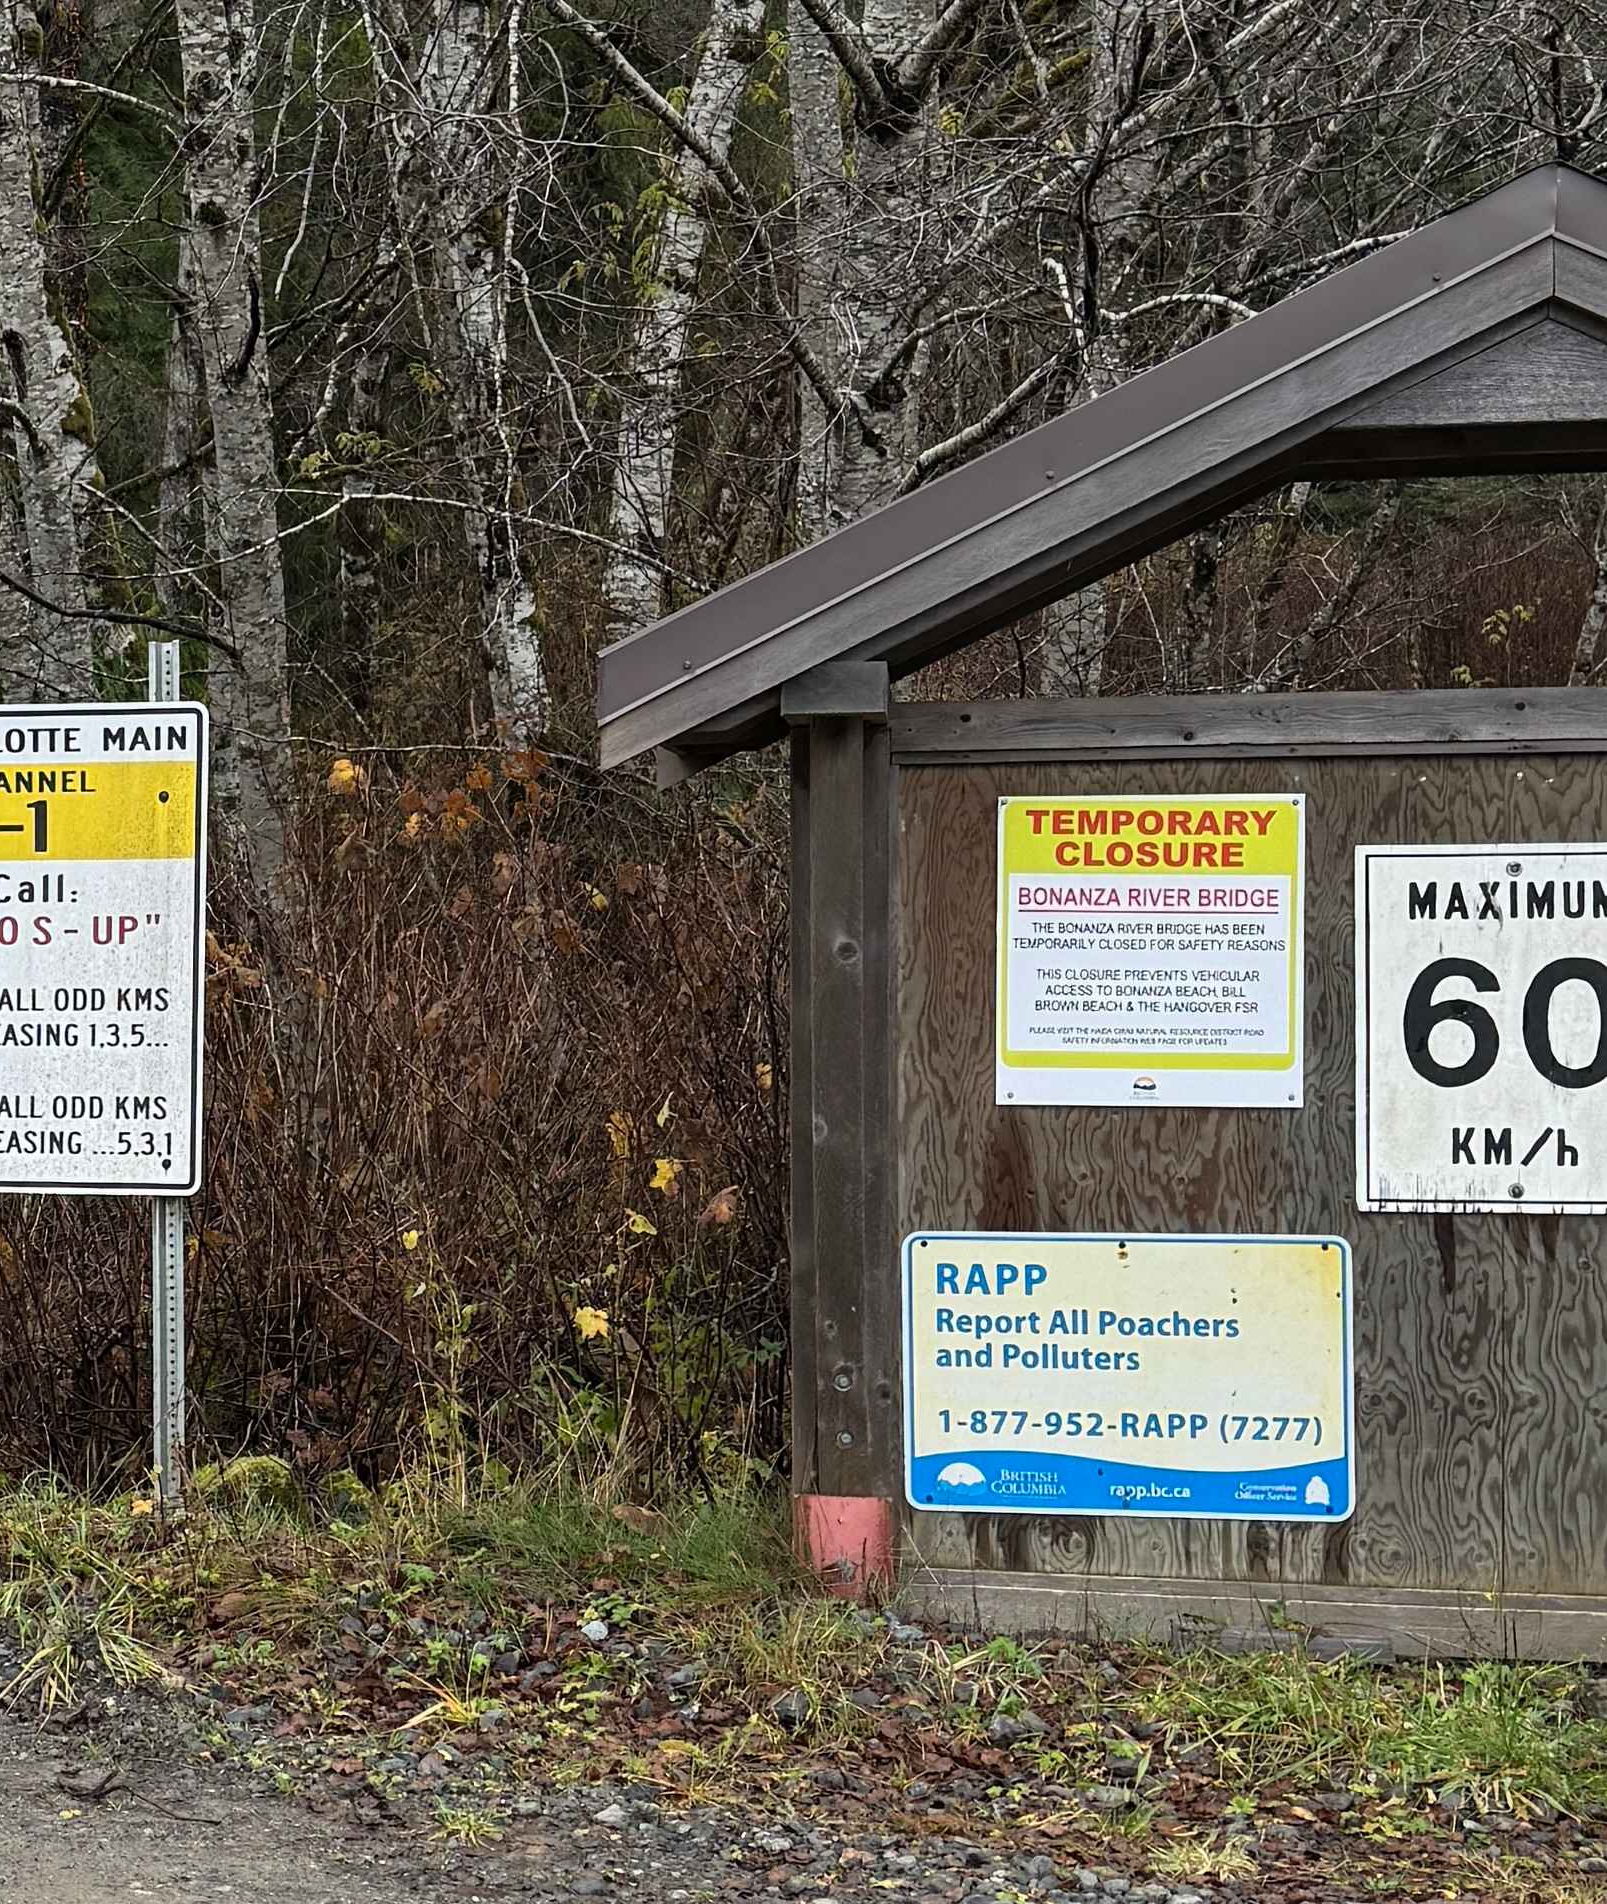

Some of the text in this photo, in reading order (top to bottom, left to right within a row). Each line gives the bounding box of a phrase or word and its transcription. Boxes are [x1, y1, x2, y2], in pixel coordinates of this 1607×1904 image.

[102, 725, 187, 751] MAIN
[1026, 810, 1277, 835] TEMPORARY
[1055, 842, 1244, 867] CLOSURE
[1018, 887, 1279, 907] BONANZA RIVER BRIDGE
[1032, 922, 1265, 935] THE BONANZA RIVER BRIDGE HAS BEEN
[1014, 937, 1285, 951] TEMPORARILY CLOSED FOR SAFETY REASONS
[1036, 968, 1260, 982] THIS CLOSURE PREVENTS VEHICULAR
[54, 988, 106, 1011] ODD
[117, 988, 170, 1011] KMS
[1045, 984, 1092, 996] ACCESS
[1097, 985, 1112, 996] TO
[1115, 985, 1172, 997] BONANZA
[1035, 1000, 1259, 1013] BROWN BEACH & THE HANGOVER FSR
[1403, 957, 1607, 1088] 60
[52, 1095, 103, 1119] ODD
[115, 1095, 167, 1120] KMS
[1452, 1126, 1578, 1167] KM/h
[936, 1263, 1048, 1296] RAPP
[936, 1309, 1240, 1339] Report All Poachers
[936, 1343, 1140, 1371] and Polluters
[938, 1410, 1322, 1445] 1-877-952-RAPP (7277)
[1110, 1483, 1190, 1500] rapp.bc.ca
